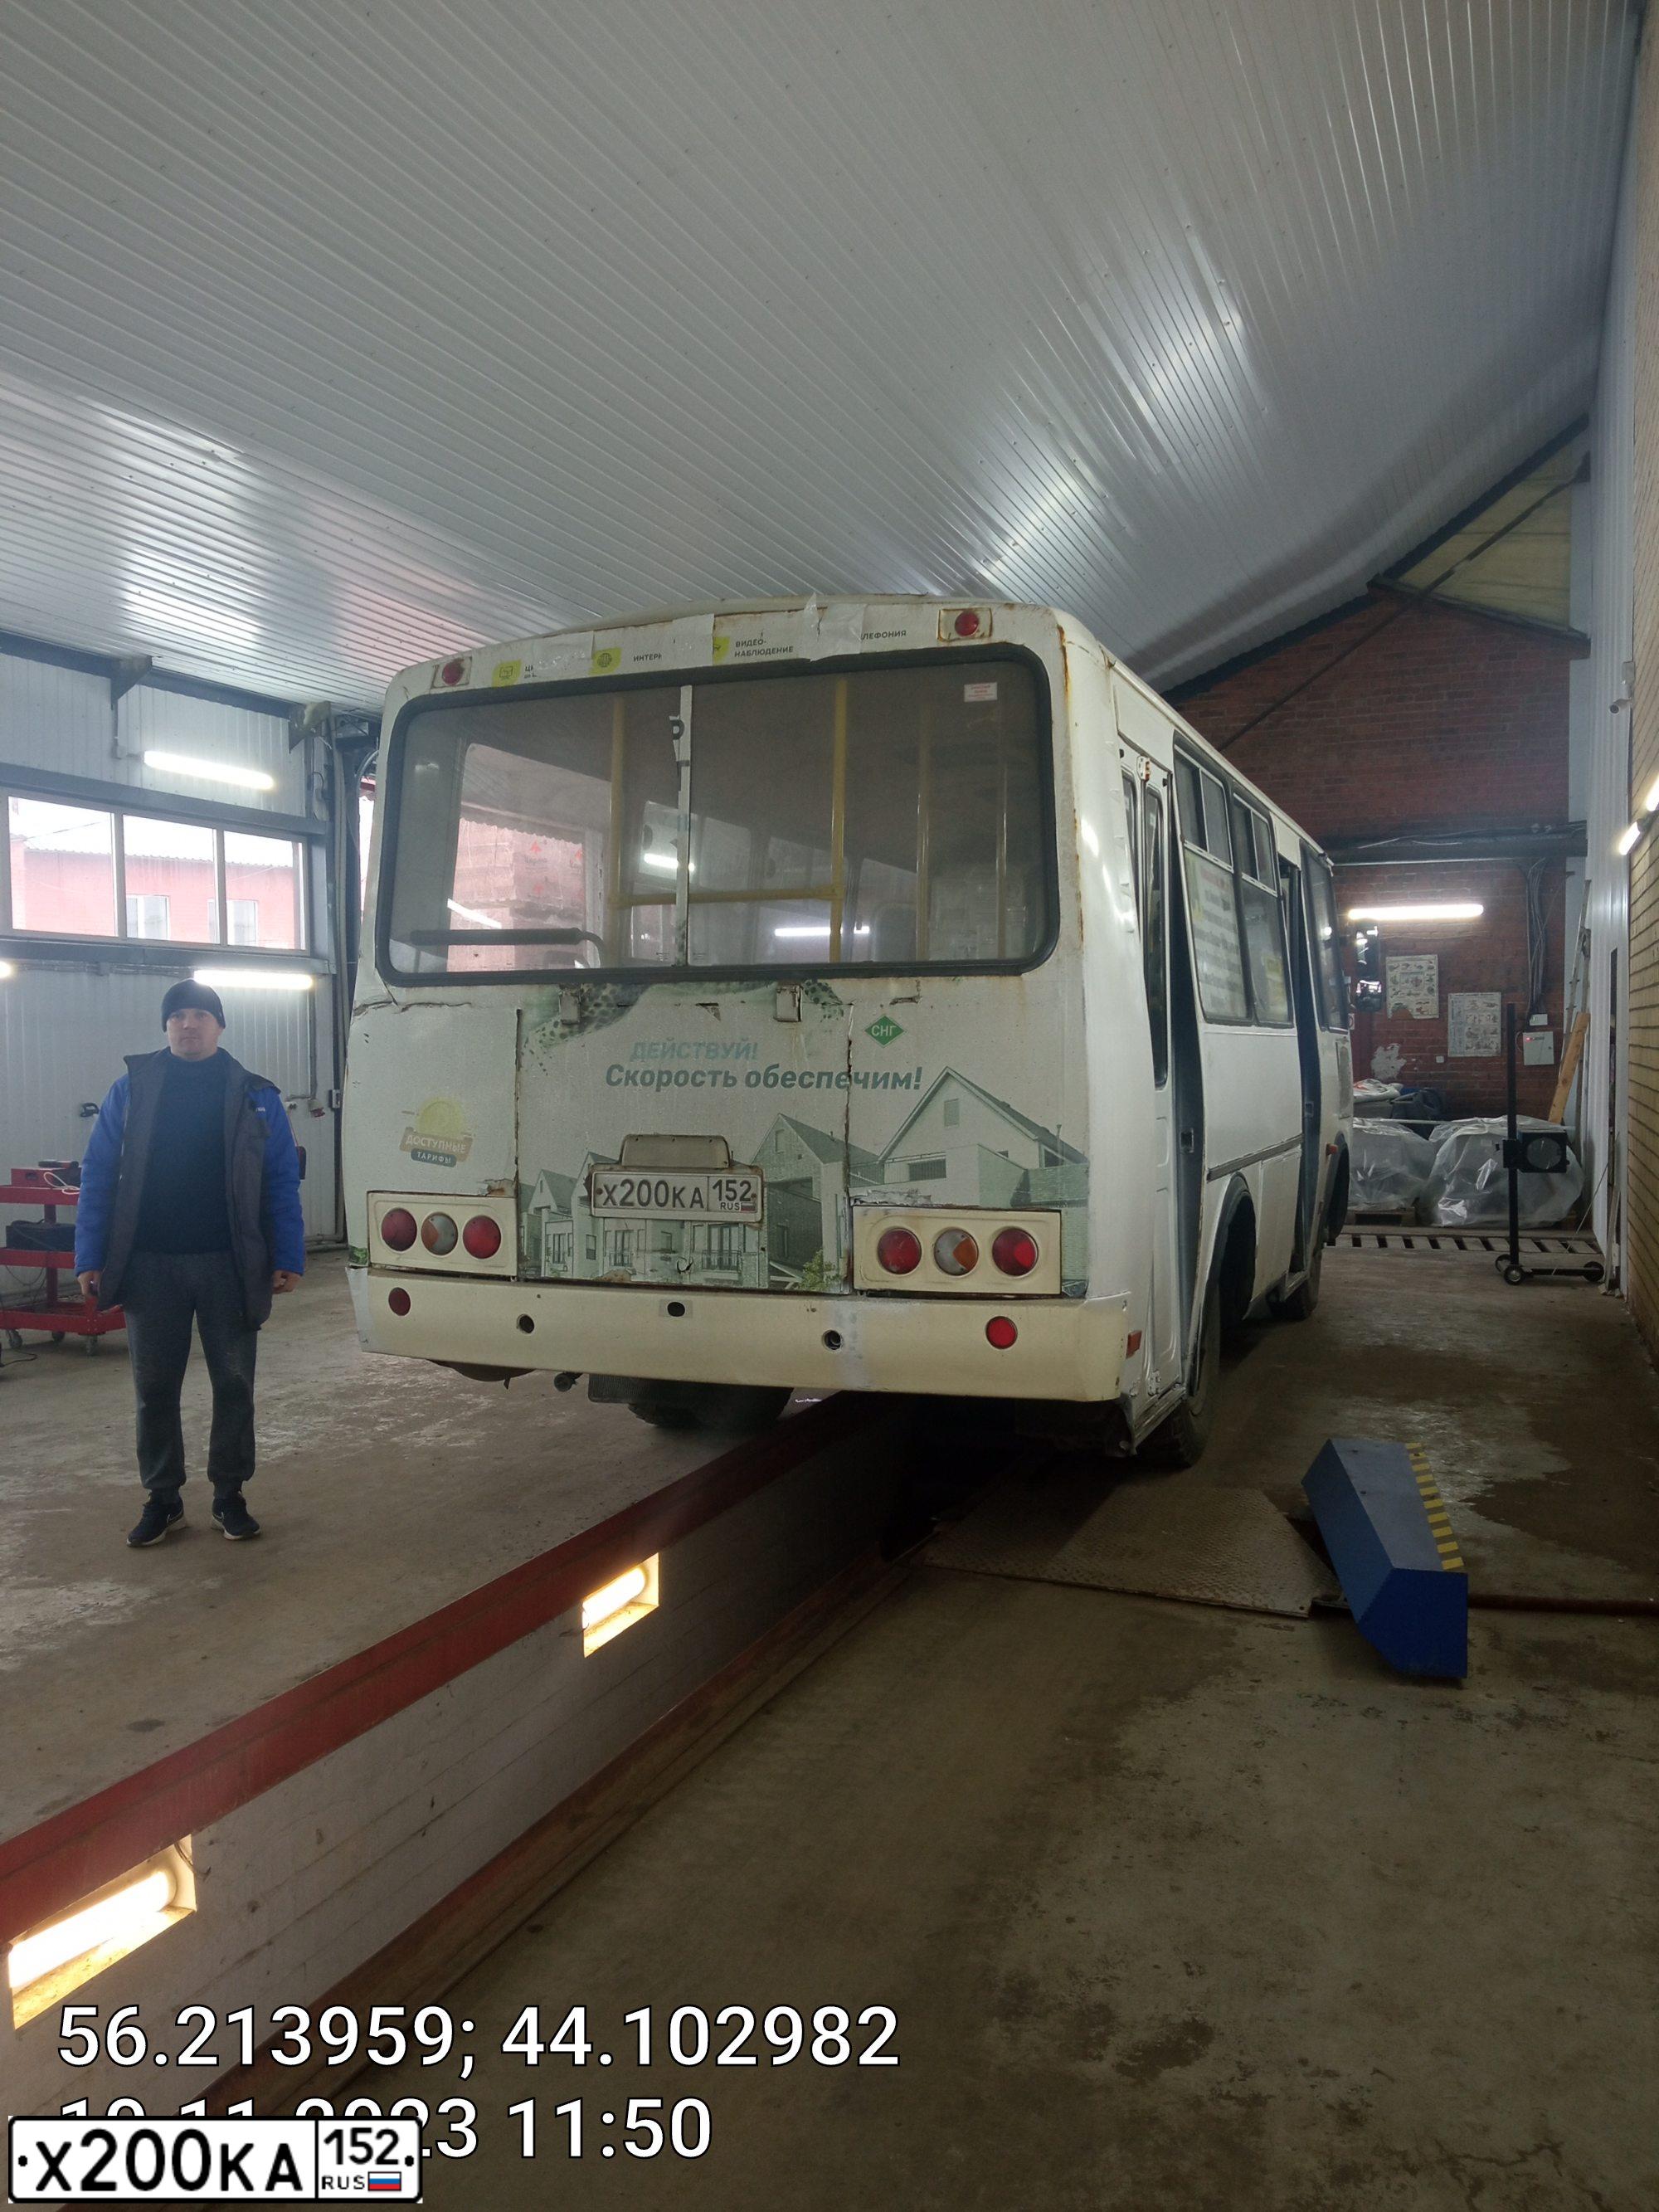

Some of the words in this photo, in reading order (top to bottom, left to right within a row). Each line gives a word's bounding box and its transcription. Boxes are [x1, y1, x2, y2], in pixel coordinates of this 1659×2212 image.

[861, 630, 907, 640] ЛЕФОНИЯ
[735, 638, 767, 648] ВИДЕО-
[734, 646, 794, 657] НАБЛЮДЕНИЕ
[871, 1024, 897, 1036] СНГ
[630, 1036, 758, 1062] ДЕЙСТВУЙ!
[606, 1064, 737, 1092] Скорость
[745, 1063, 922, 1090] обеспечим!
[405, 1134, 467, 1153] ДОСТУПНЫЕ
[417, 1151, 451, 1163] ТАРИФЫ
[713, 1179, 752, 1202] 152
[720, 1201, 740, 1211] RUS
